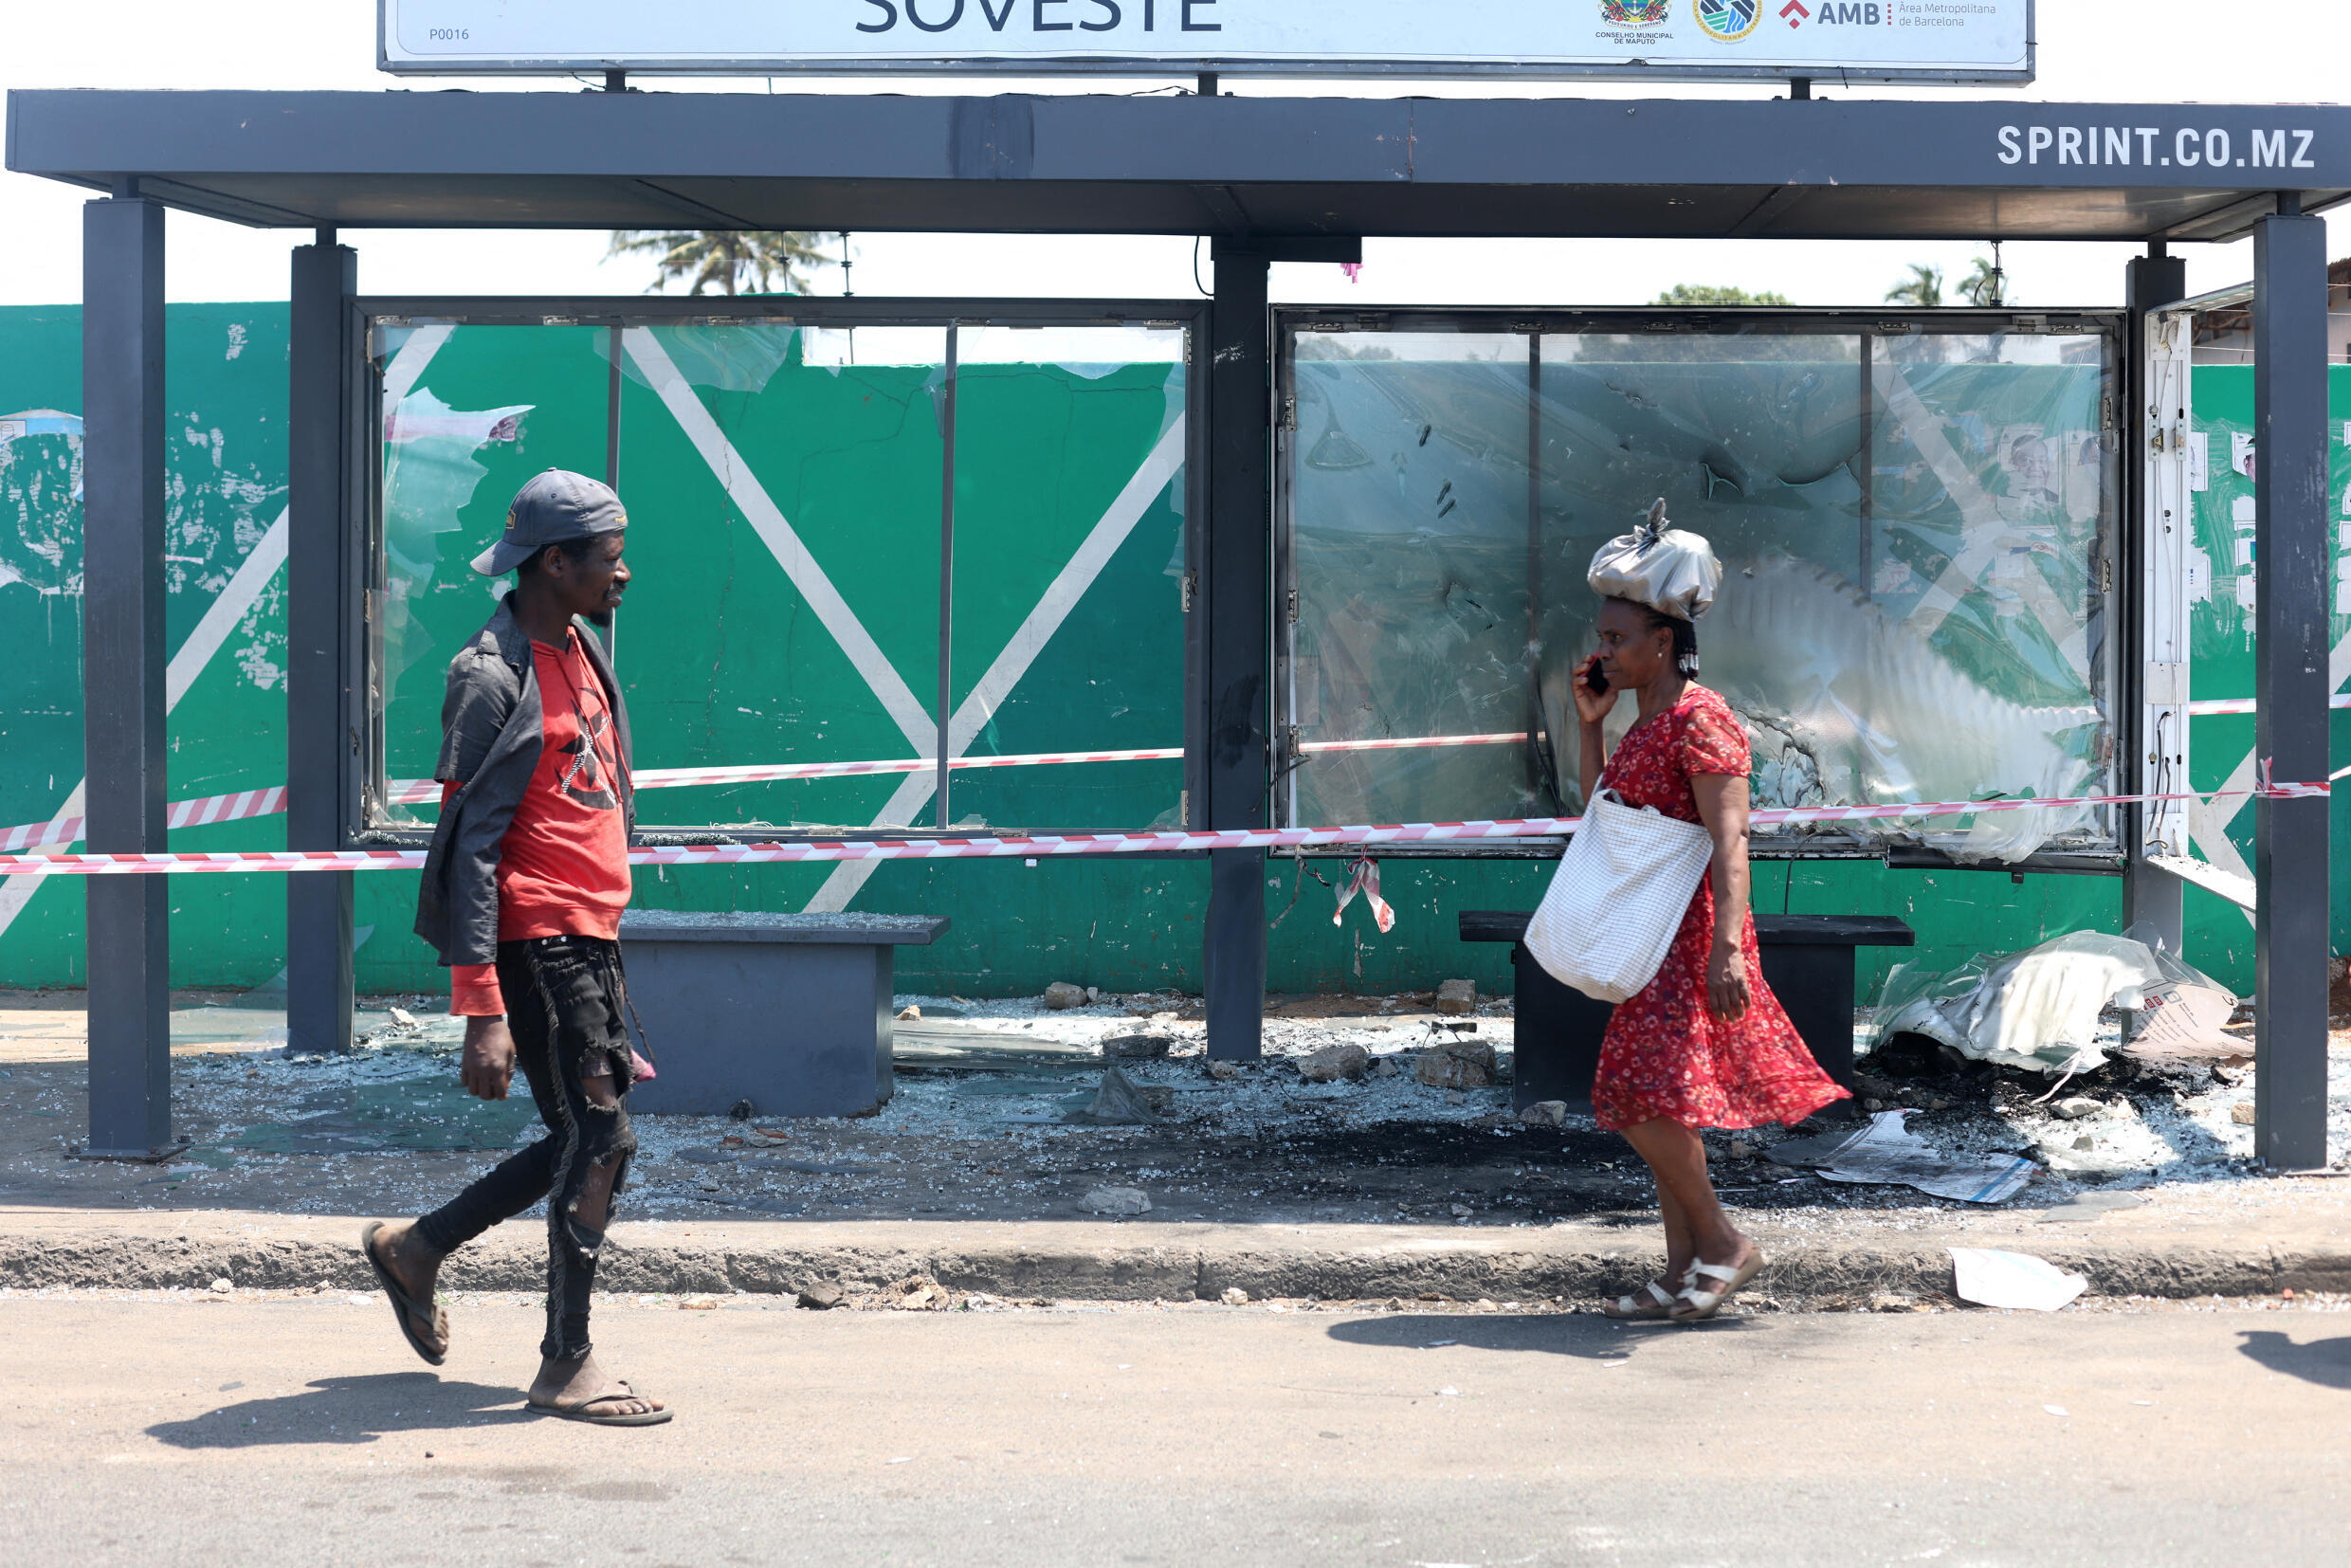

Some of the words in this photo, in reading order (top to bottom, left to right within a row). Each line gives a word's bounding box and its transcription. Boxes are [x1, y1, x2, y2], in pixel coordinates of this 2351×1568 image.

[1817, 2, 1881, 25] AMB
[1924, 3, 1996, 15] Metropolitana
[1899, 16, 1912, 27] de
[1914, 16, 1964, 27] Barcelona
[429, 28, 469, 40] P0016
[1996, 125, 2315, 169] SPRINT.CO.MZ
